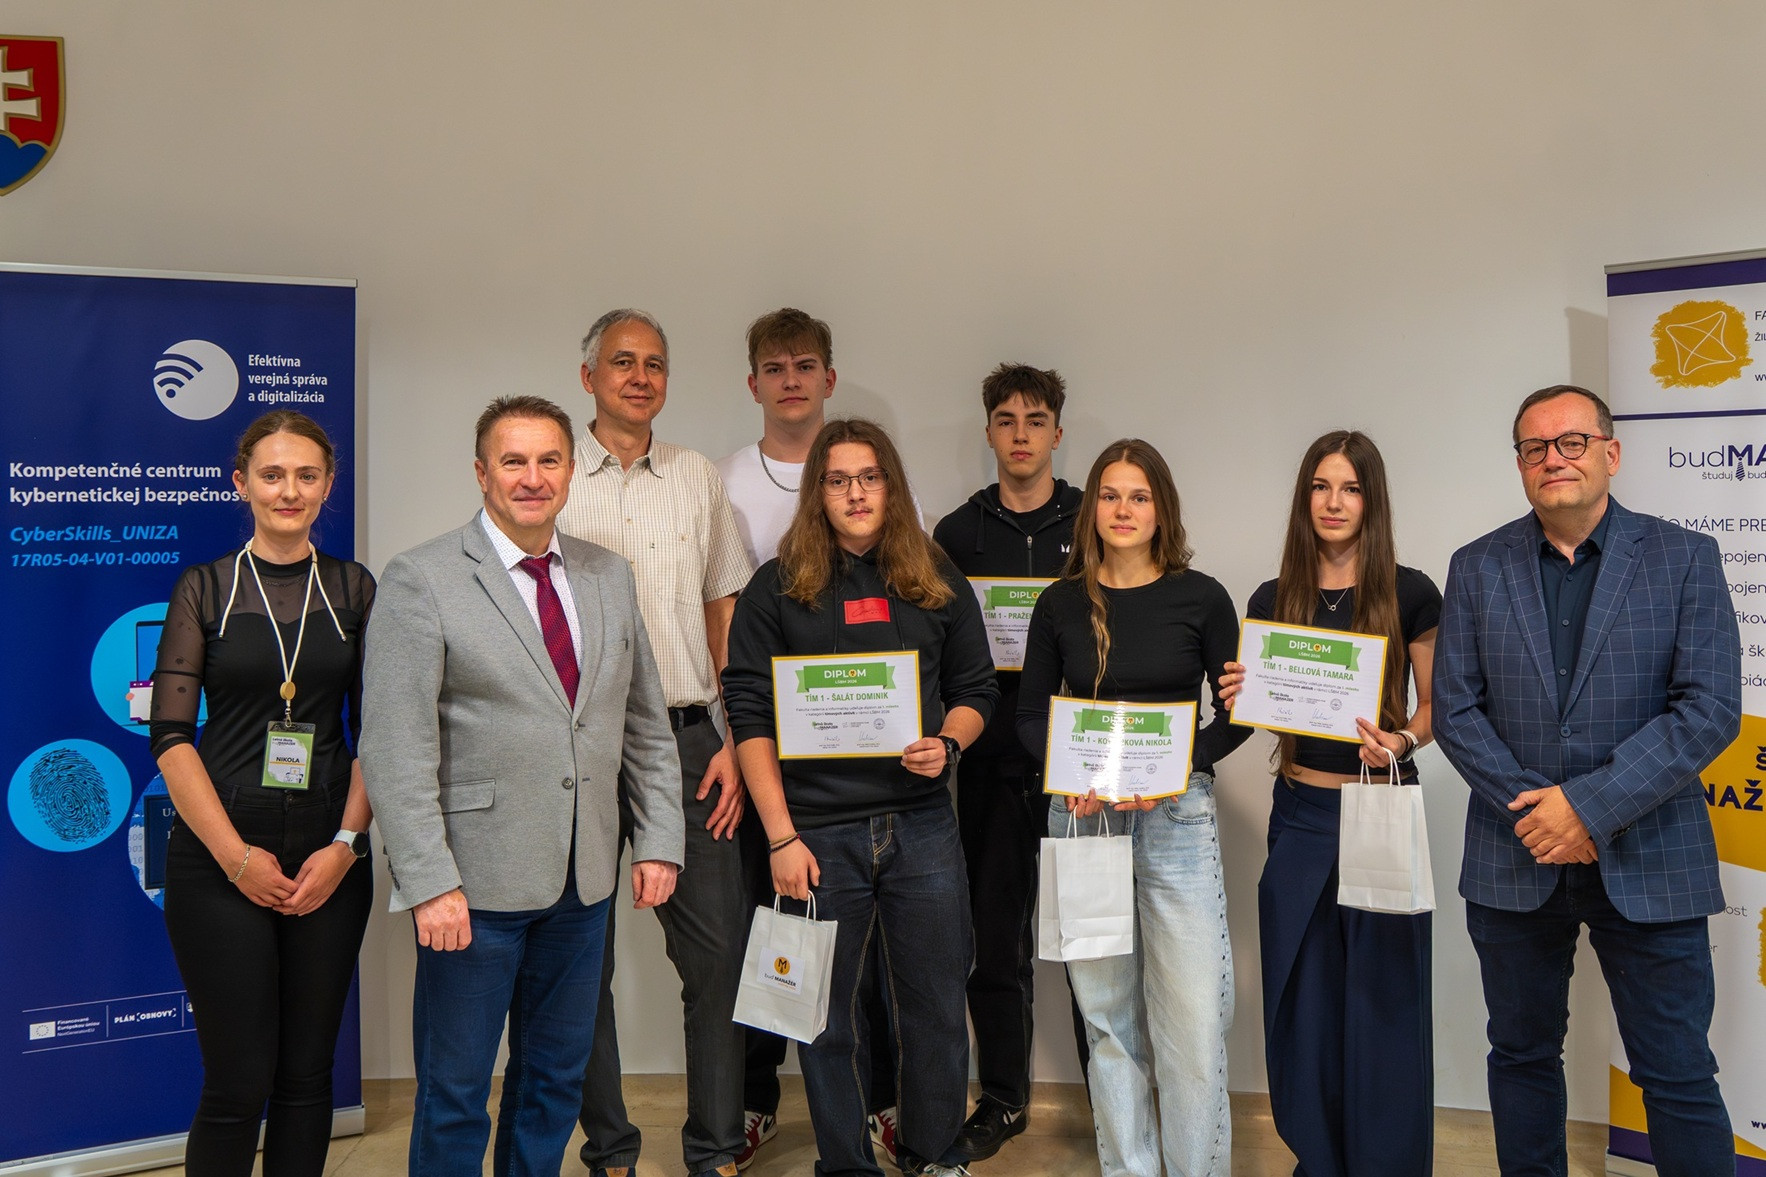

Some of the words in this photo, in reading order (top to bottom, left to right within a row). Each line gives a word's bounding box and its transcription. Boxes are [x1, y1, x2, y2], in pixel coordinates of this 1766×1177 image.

[248, 354, 301, 368] Efektívna
[248, 373, 290, 388] verejná
[292, 374, 328, 388] správa
[248, 393, 255, 402] a
[257, 390, 325, 405] digitalizácia
[10, 462, 142, 481] Kompetenčné
[146, 464, 222, 479] centrum
[1702, 470, 1733, 481] študuj
[10, 487, 140, 506] kybernetickej
[145, 487, 240, 505] bezpečnos
[1685, 516, 1734, 532] MÁME
[10, 525, 179, 544] CyberSkills_UNIZA
[11, 552, 180, 568] 17R05-04-V01-00005
[1289, 640, 1331, 654] DIPLOM
[824, 669, 866, 679] DIPLOM
[1263, 661, 1276, 670] TÍM
[1289, 665, 1321, 677] BELLOVÁ
[1323, 670, 1354, 681] TAMARA
[806, 694, 818, 702] TÍM
[832, 692, 854, 701] ŠALÁT
[856, 692, 888, 700] DOMINIK
[1071, 734, 1084, 742] TÍM
[1724, 906, 1747, 917] ost
[114, 1014, 135, 1023] PLÁN
[140, 1010, 172, 1020] OBNOVY
